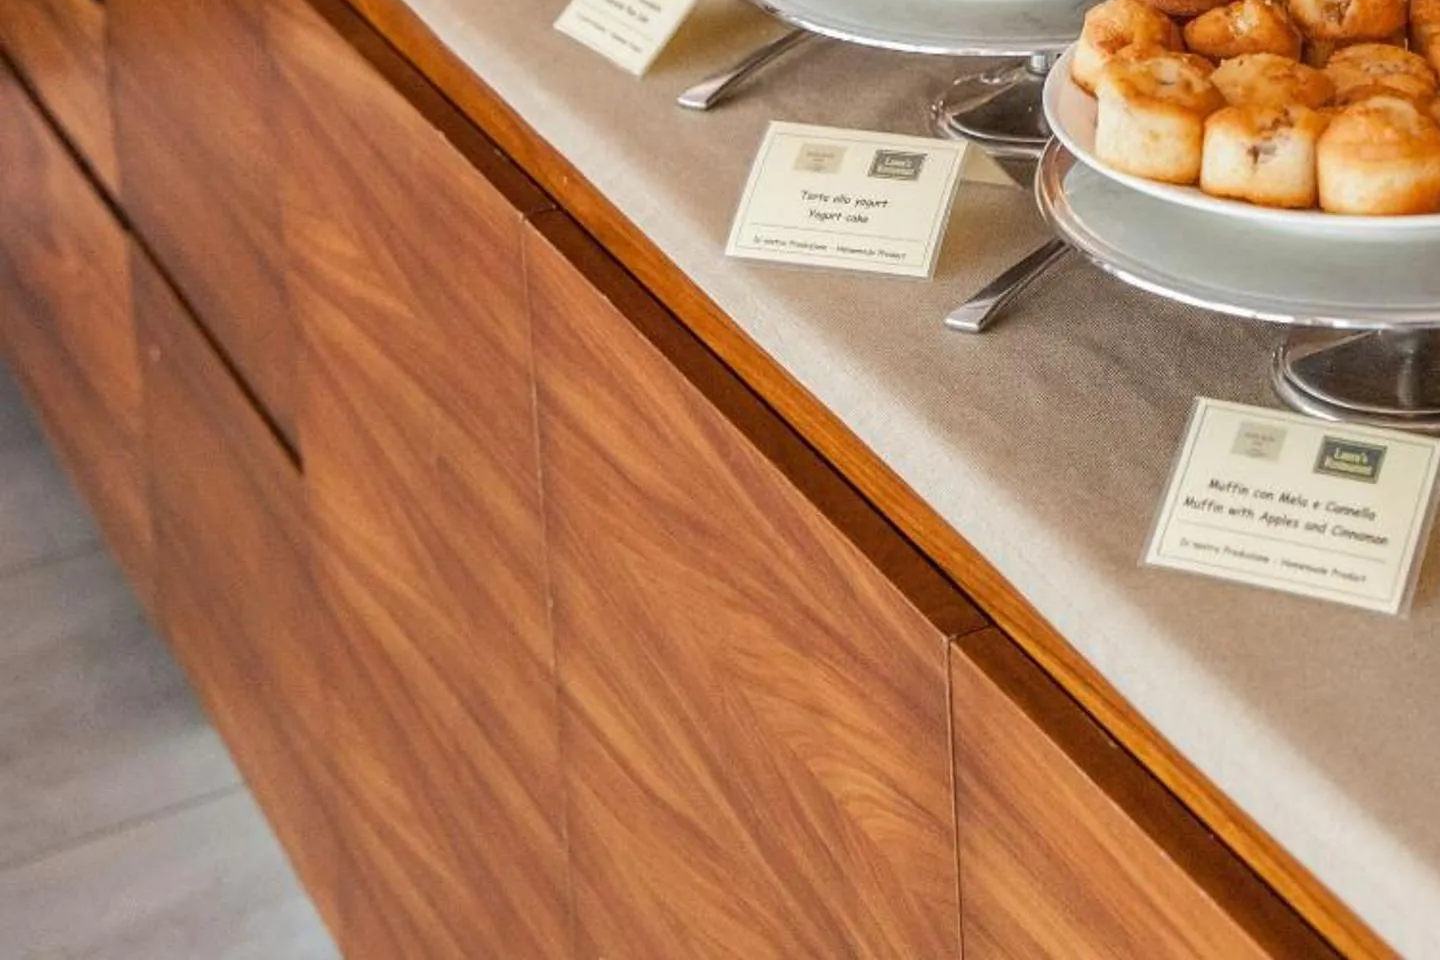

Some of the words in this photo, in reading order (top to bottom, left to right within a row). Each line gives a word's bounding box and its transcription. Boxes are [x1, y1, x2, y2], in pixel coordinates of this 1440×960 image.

[855, 198, 888, 209] yogurt
[809, 208, 841, 222] Yogurt
[1208, 478, 1248, 495] Muffin
[1253, 489, 1274, 501] con
[1279, 492, 1308, 507] Mela
[1325, 501, 1376, 521] Cannella
[1184, 496, 1224, 513] Muffin
[1228, 507, 1254, 519] with
[1259, 511, 1298, 529] Apples
[1304, 520, 1327, 534] and
[1332, 524, 1388, 545] Cinnamon
[1332, 568, 1366, 582] Product
